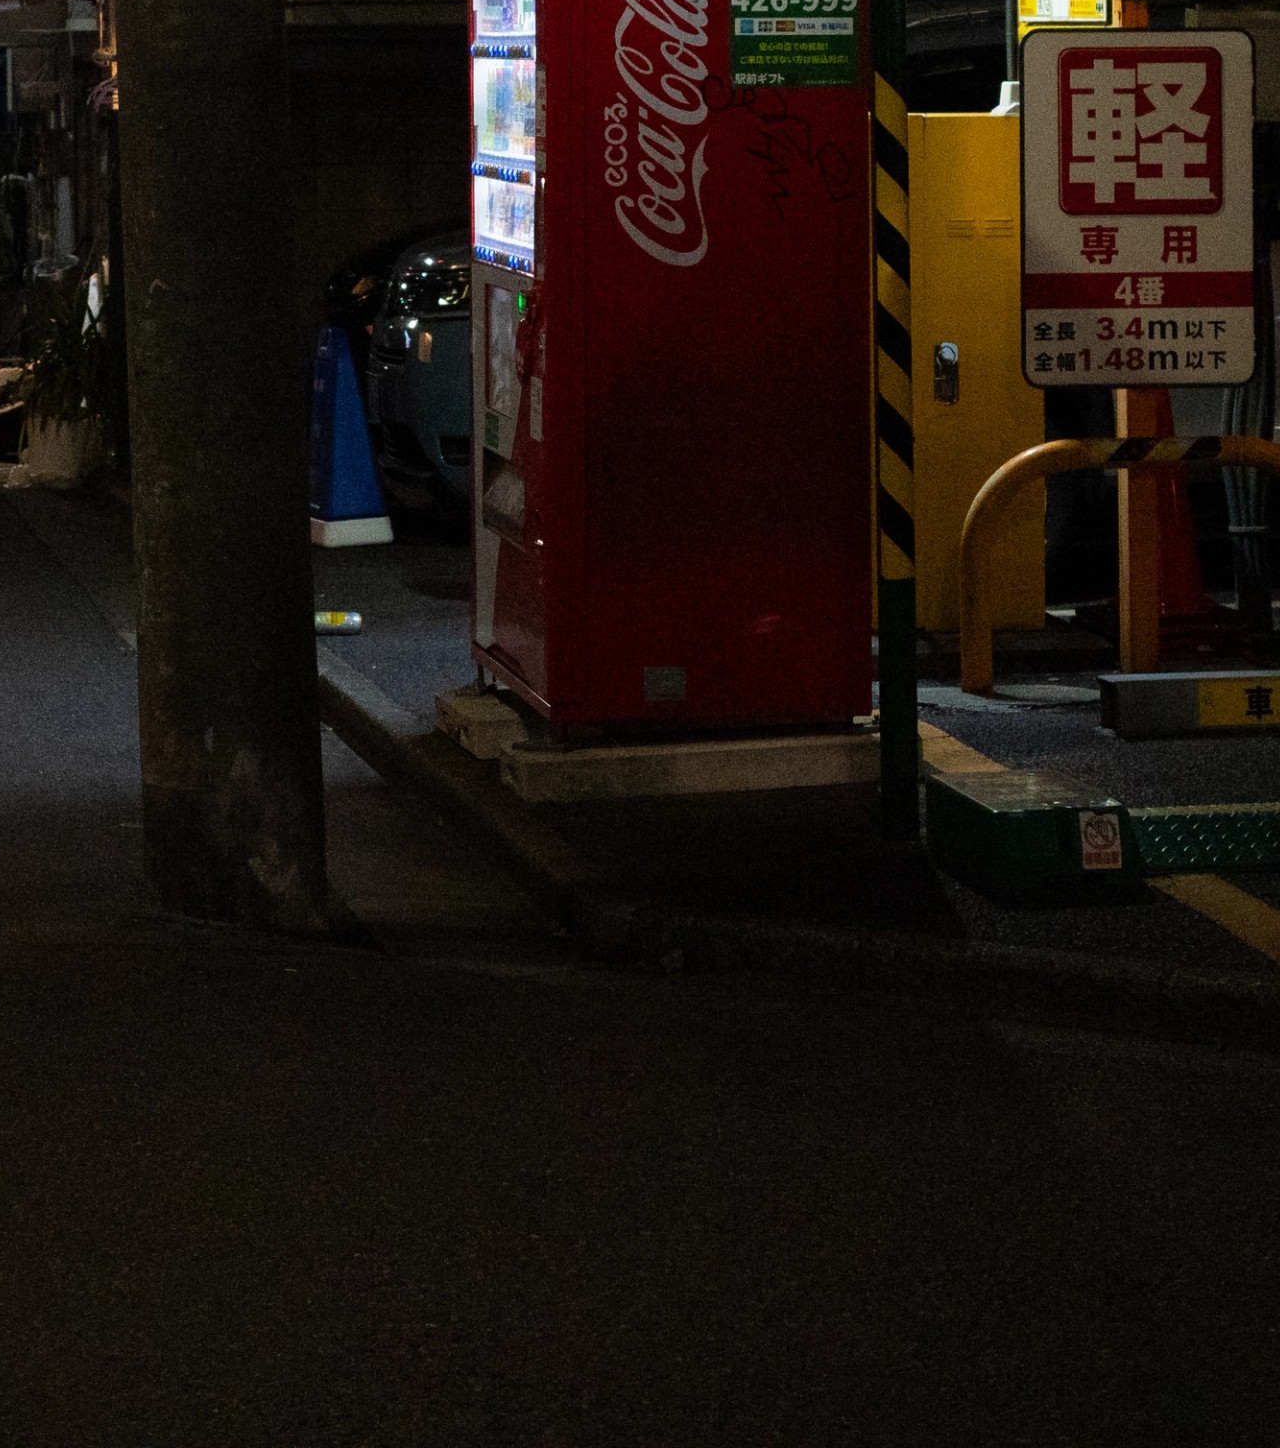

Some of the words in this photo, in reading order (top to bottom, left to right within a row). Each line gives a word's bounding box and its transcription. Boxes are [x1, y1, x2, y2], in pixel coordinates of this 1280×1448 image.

[797, 22, 817, 31] VISA
[735, 72, 786, 86] 駅前ギフト
[1068, 58, 1218, 204] 軽
[1114, 276, 1165, 306] 4番
